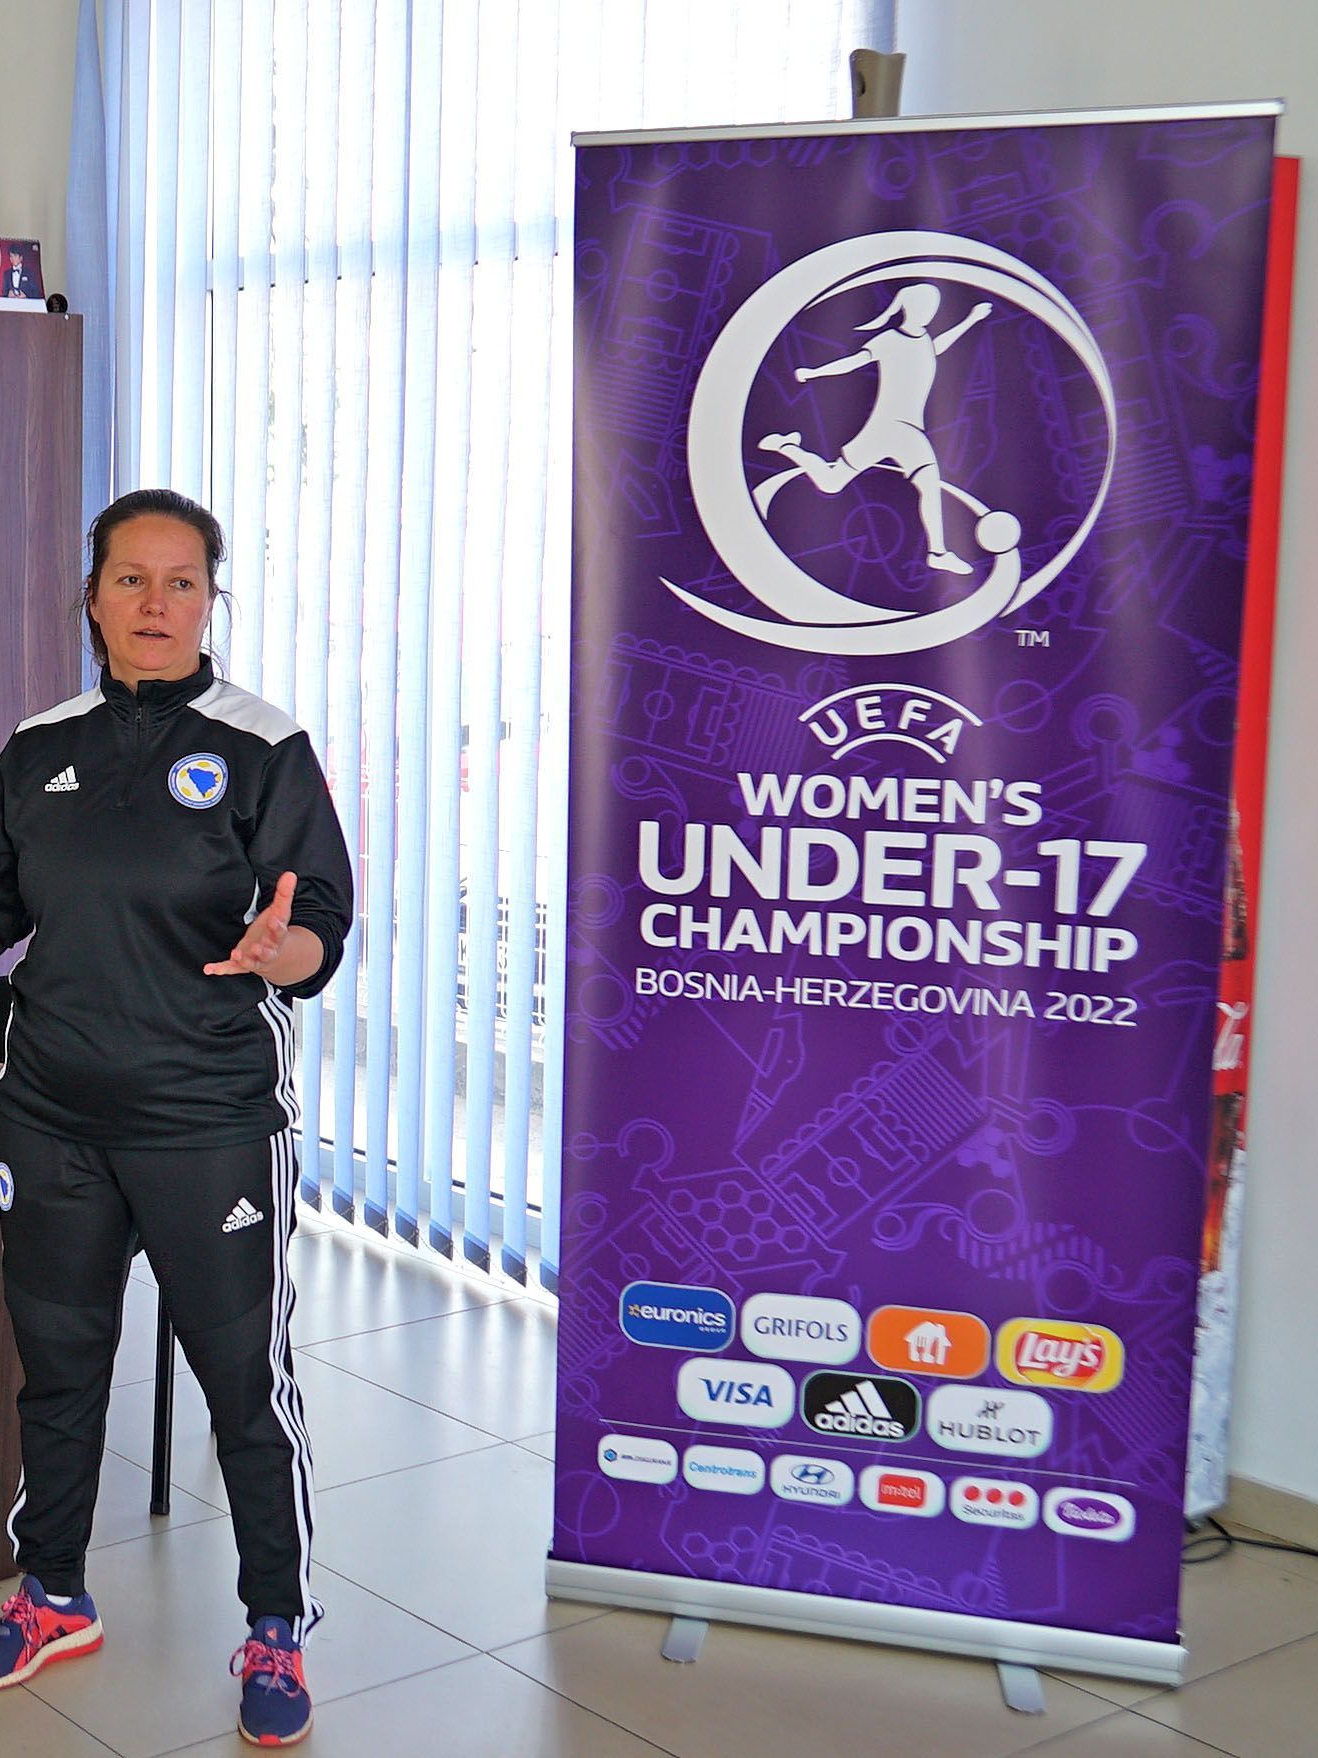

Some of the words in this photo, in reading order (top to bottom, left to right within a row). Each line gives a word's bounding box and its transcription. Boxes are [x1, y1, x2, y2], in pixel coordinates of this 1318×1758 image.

[809, 695, 964, 755] UEFA
[737, 772, 1043, 827] WOMEN'S
[638, 820, 1148, 917] UNDER-17
[639, 903, 1139, 973] CHAMPIONSHIP
[635, 967, 1035, 1019] BOSNIA-HERZEGOVINA
[1044, 992, 1139, 1027] 2022
[222, 1210, 264, 1233] adidas
[639, 1304, 726, 1327] euronics
[753, 1315, 849, 1342] GRIFOLS
[1017, 1330, 1103, 1378] Lay's
[698, 1377, 774, 1408] VISA
[813, 1408, 905, 1439] adidas
[938, 1420, 1042, 1447] HUBLOT
[688, 1460, 758, 1480] Centrotrans
[782, 1483, 842, 1500] HYUNDAI
